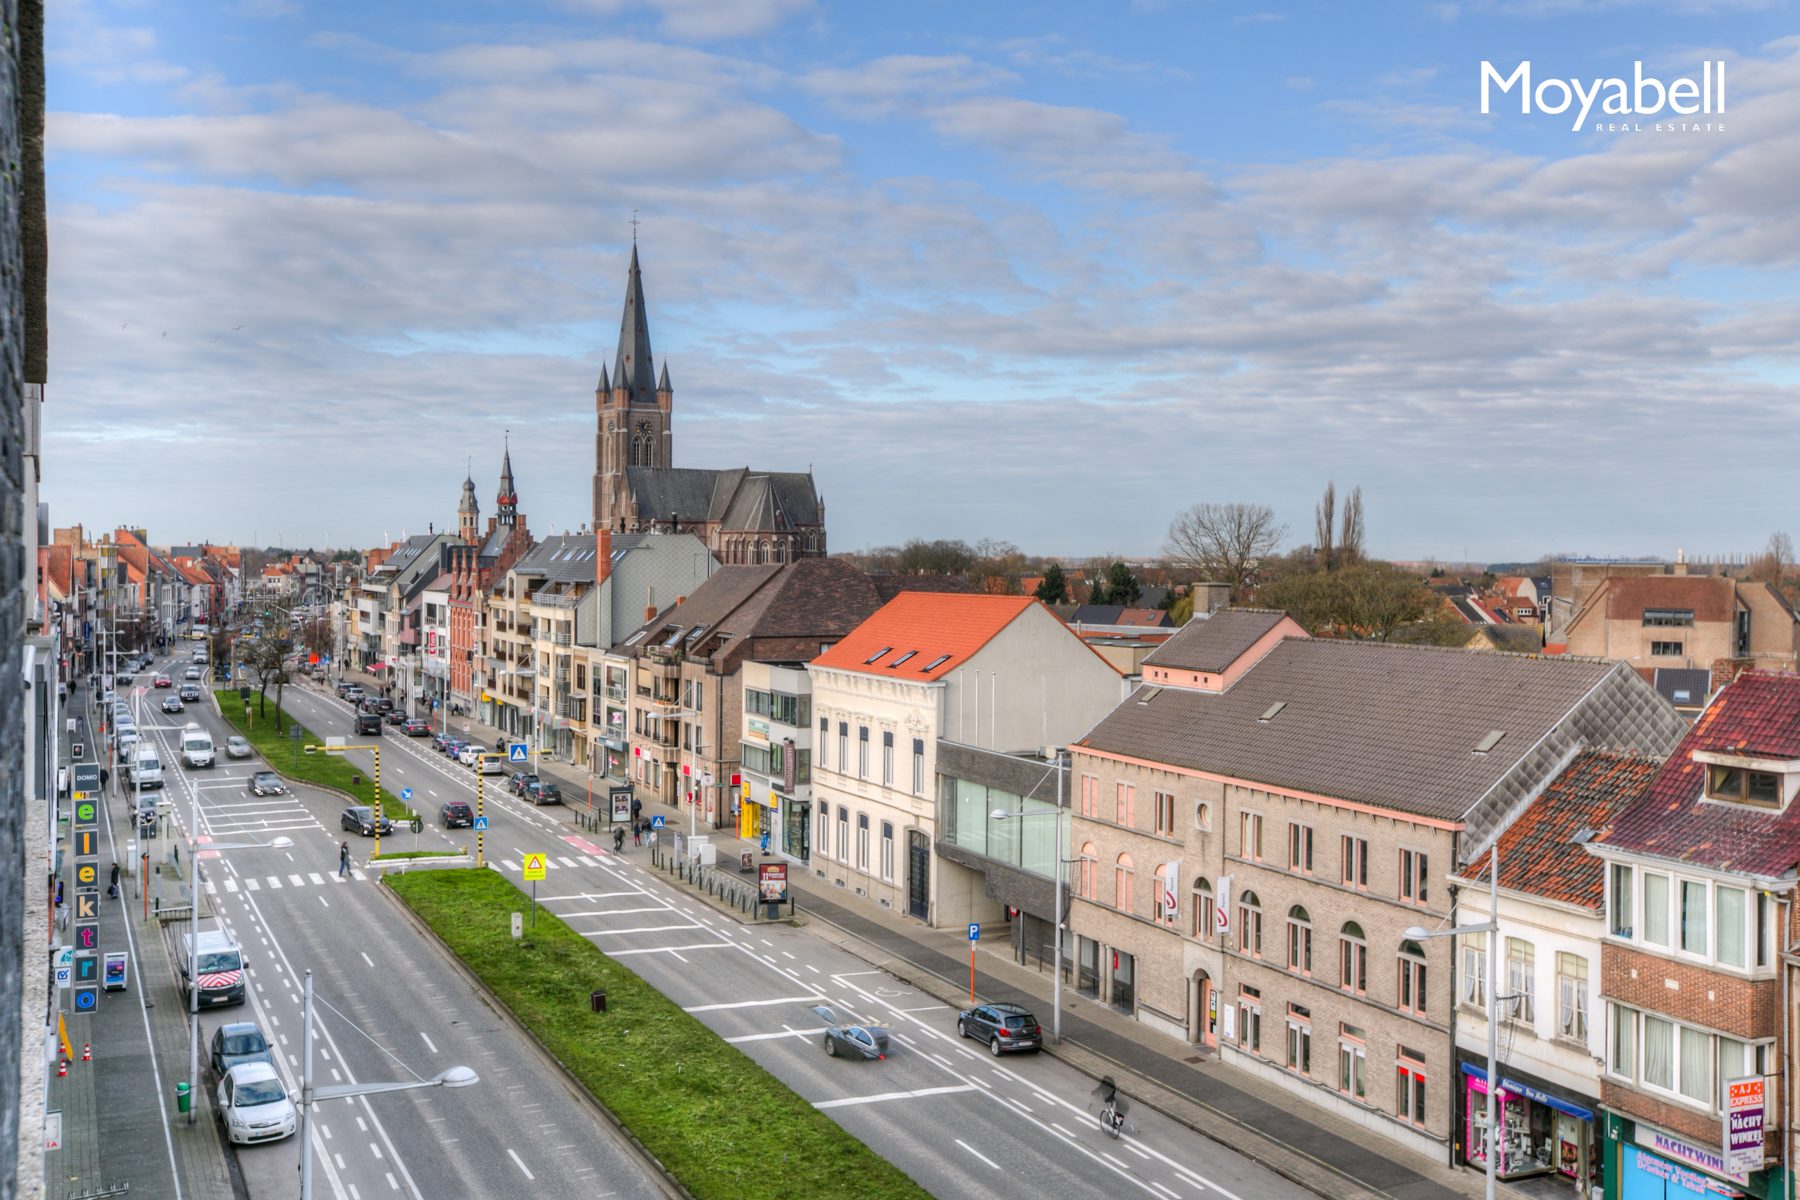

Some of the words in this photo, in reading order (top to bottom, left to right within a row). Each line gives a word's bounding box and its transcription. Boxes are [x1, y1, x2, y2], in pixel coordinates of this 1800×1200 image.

[970, 925, 978, 937] P
[1730, 1094, 1763, 1107] EXPRESS
[1731, 1114, 1762, 1131] NACHT
[1730, 1130, 1763, 1145] WINKEL
[1637, 1151, 1673, 1172] Algemene
[1675, 1165, 1706, 1187] Voeding
[1637, 1160, 1669, 1180] Dranken
[1681, 1177, 1705, 1195] Tabak
